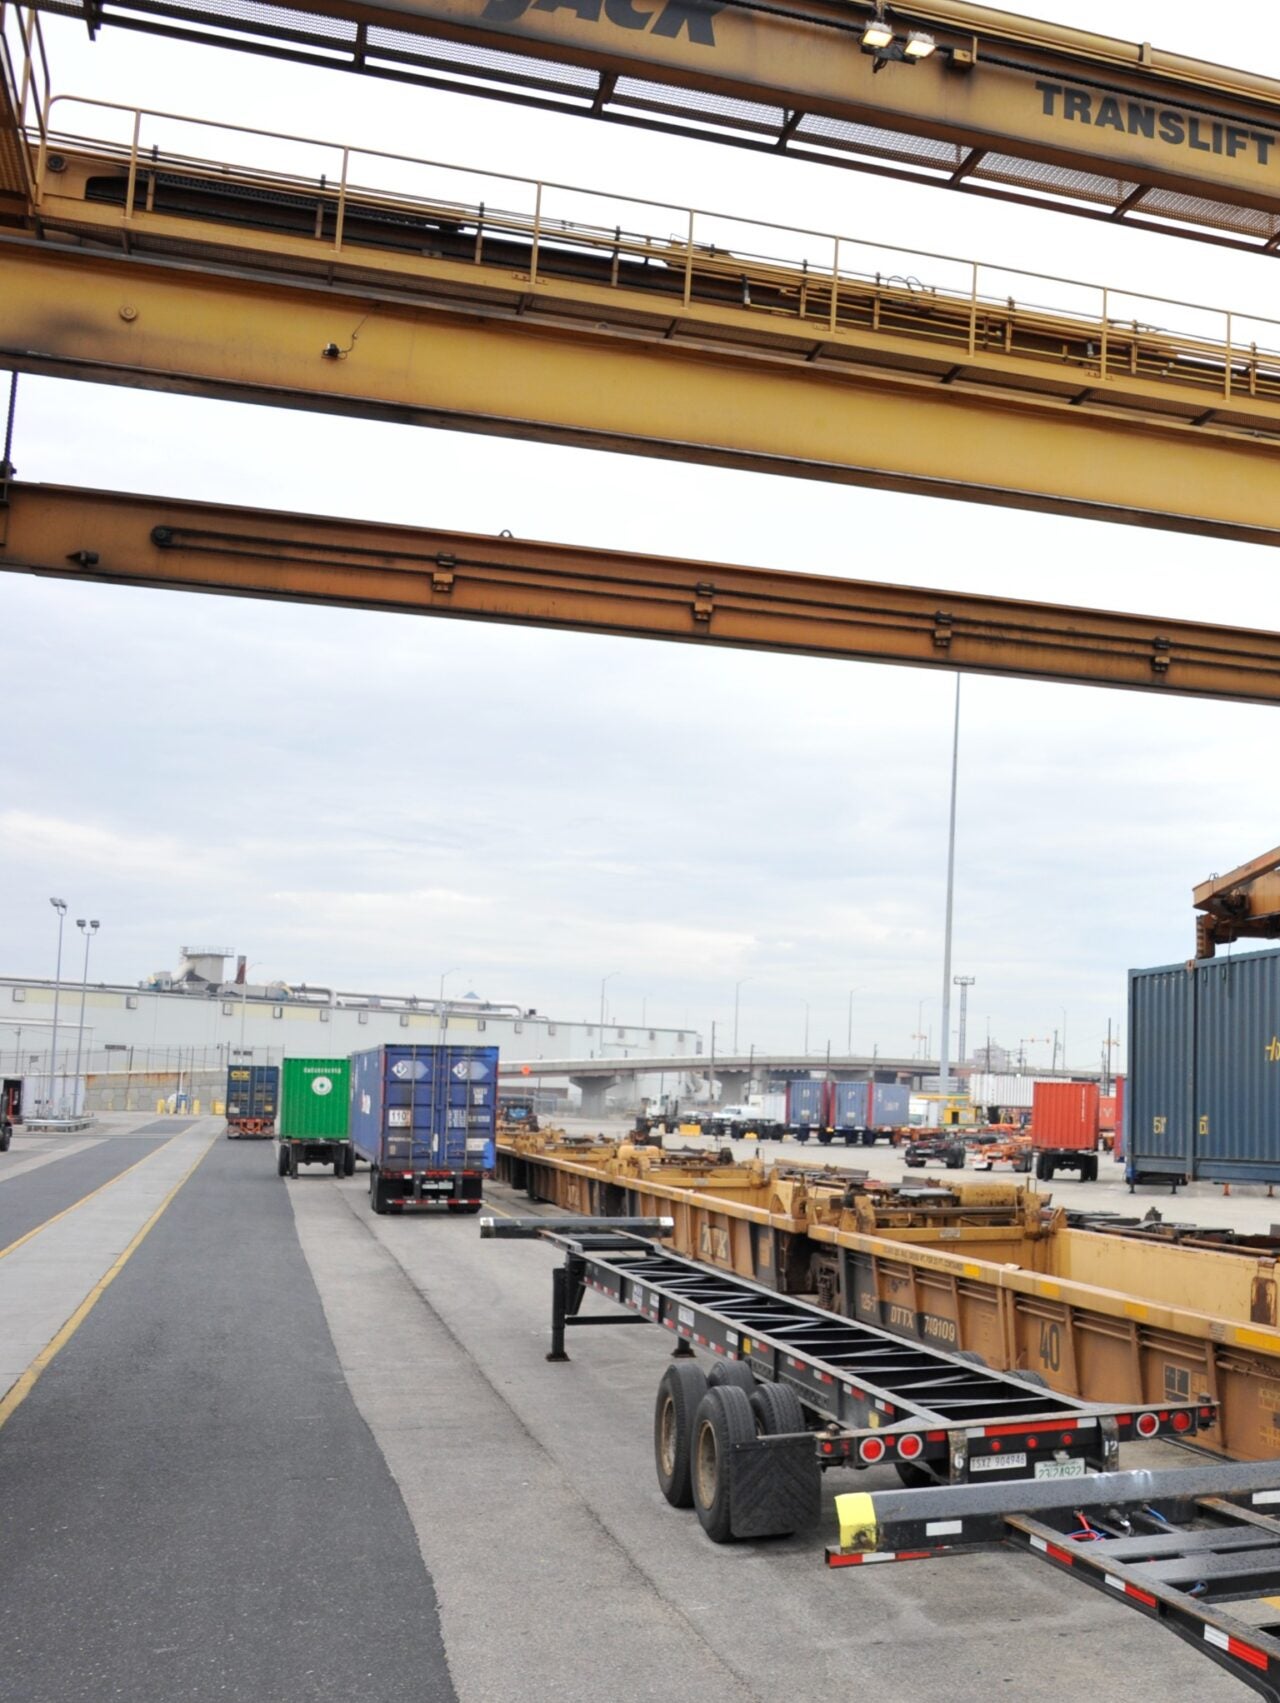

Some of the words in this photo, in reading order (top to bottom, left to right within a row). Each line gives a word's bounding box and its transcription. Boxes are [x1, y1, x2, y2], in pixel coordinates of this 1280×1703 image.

[1035, 80, 1276, 165] TRANSLIFT
[890, 1305, 914, 1329] DTTX
[1039, 1320, 1061, 1372] 40
[1104, 1440, 1119, 1456] 12
